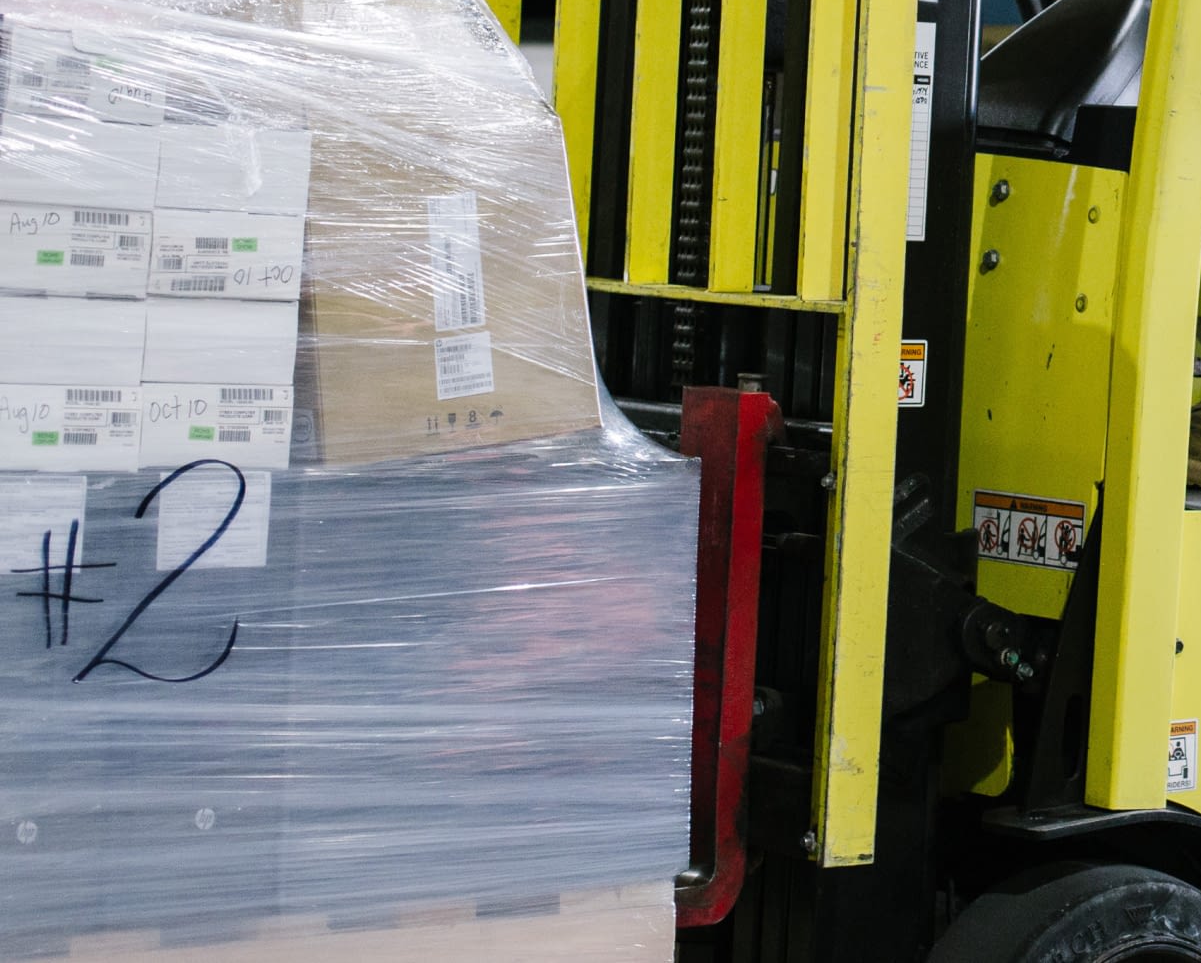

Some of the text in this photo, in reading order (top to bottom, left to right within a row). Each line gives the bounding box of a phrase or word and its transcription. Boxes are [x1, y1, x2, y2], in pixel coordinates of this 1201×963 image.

[913, 60, 929, 69] NCE
[914, 51, 929, 60] TIVE
[9, 212, 61, 235] Aug 10
[233, 265, 294, 287] Oct 10
[901, 348, 922, 356] RNING
[32, 403, 50, 422] 10
[187, 399, 208, 419] 10
[11, 459, 246, 684] #2
[1170, 724, 1194, 733] ARNING
